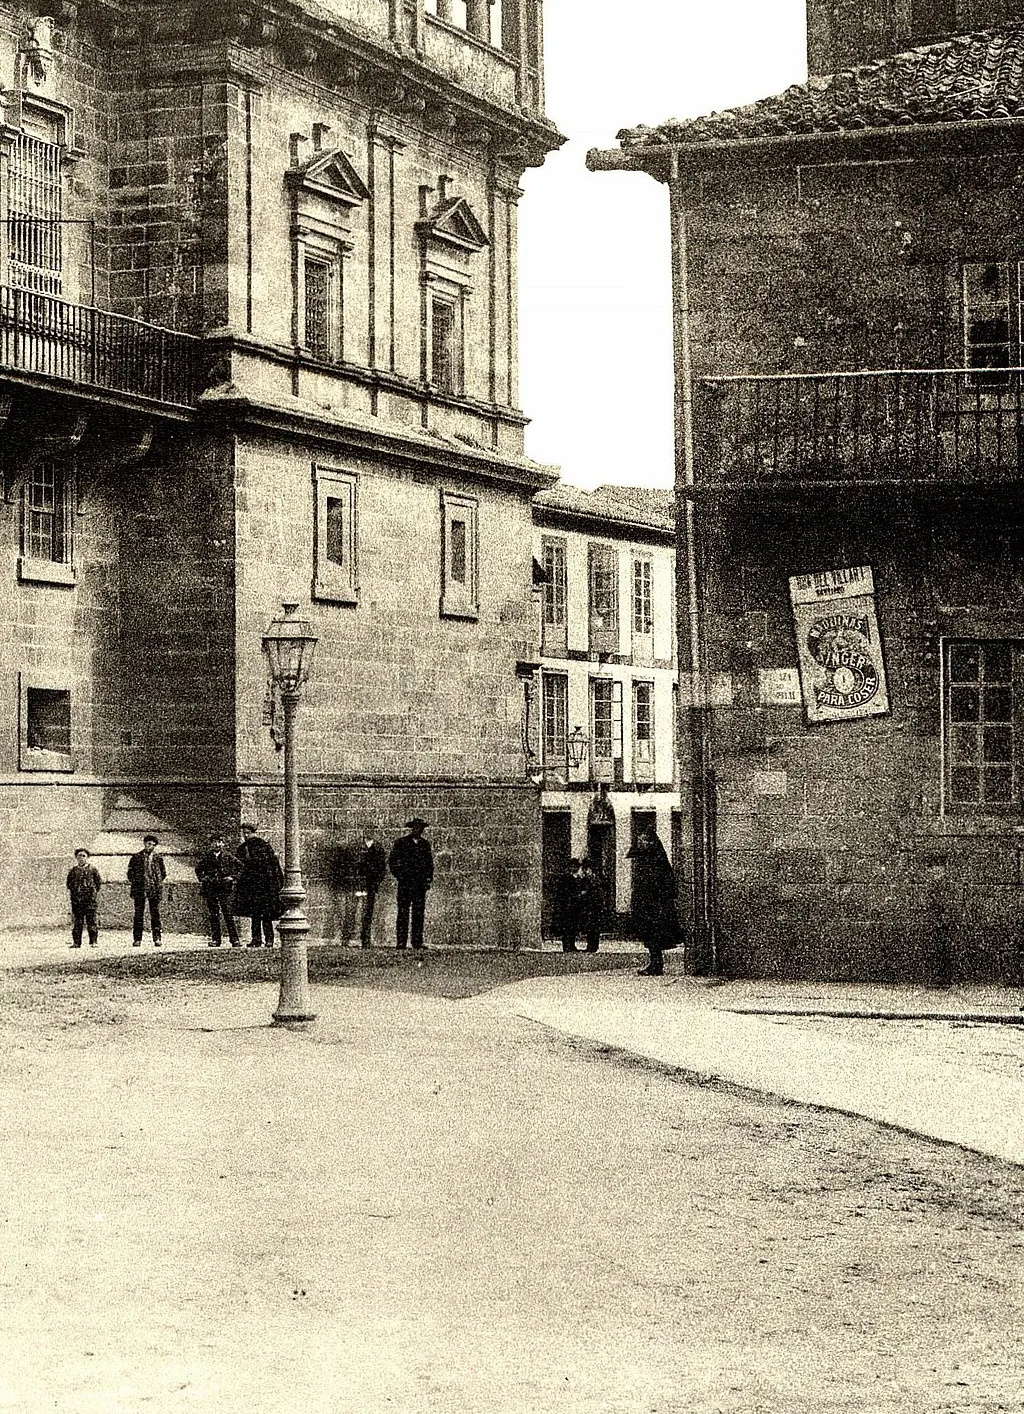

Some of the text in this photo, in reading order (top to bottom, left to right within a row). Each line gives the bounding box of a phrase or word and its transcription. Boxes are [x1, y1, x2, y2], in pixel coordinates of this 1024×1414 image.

[816, 652, 866, 669] SINGER
[818, 691, 845, 706] PARA
[848, 677, 876, 705] COSER
